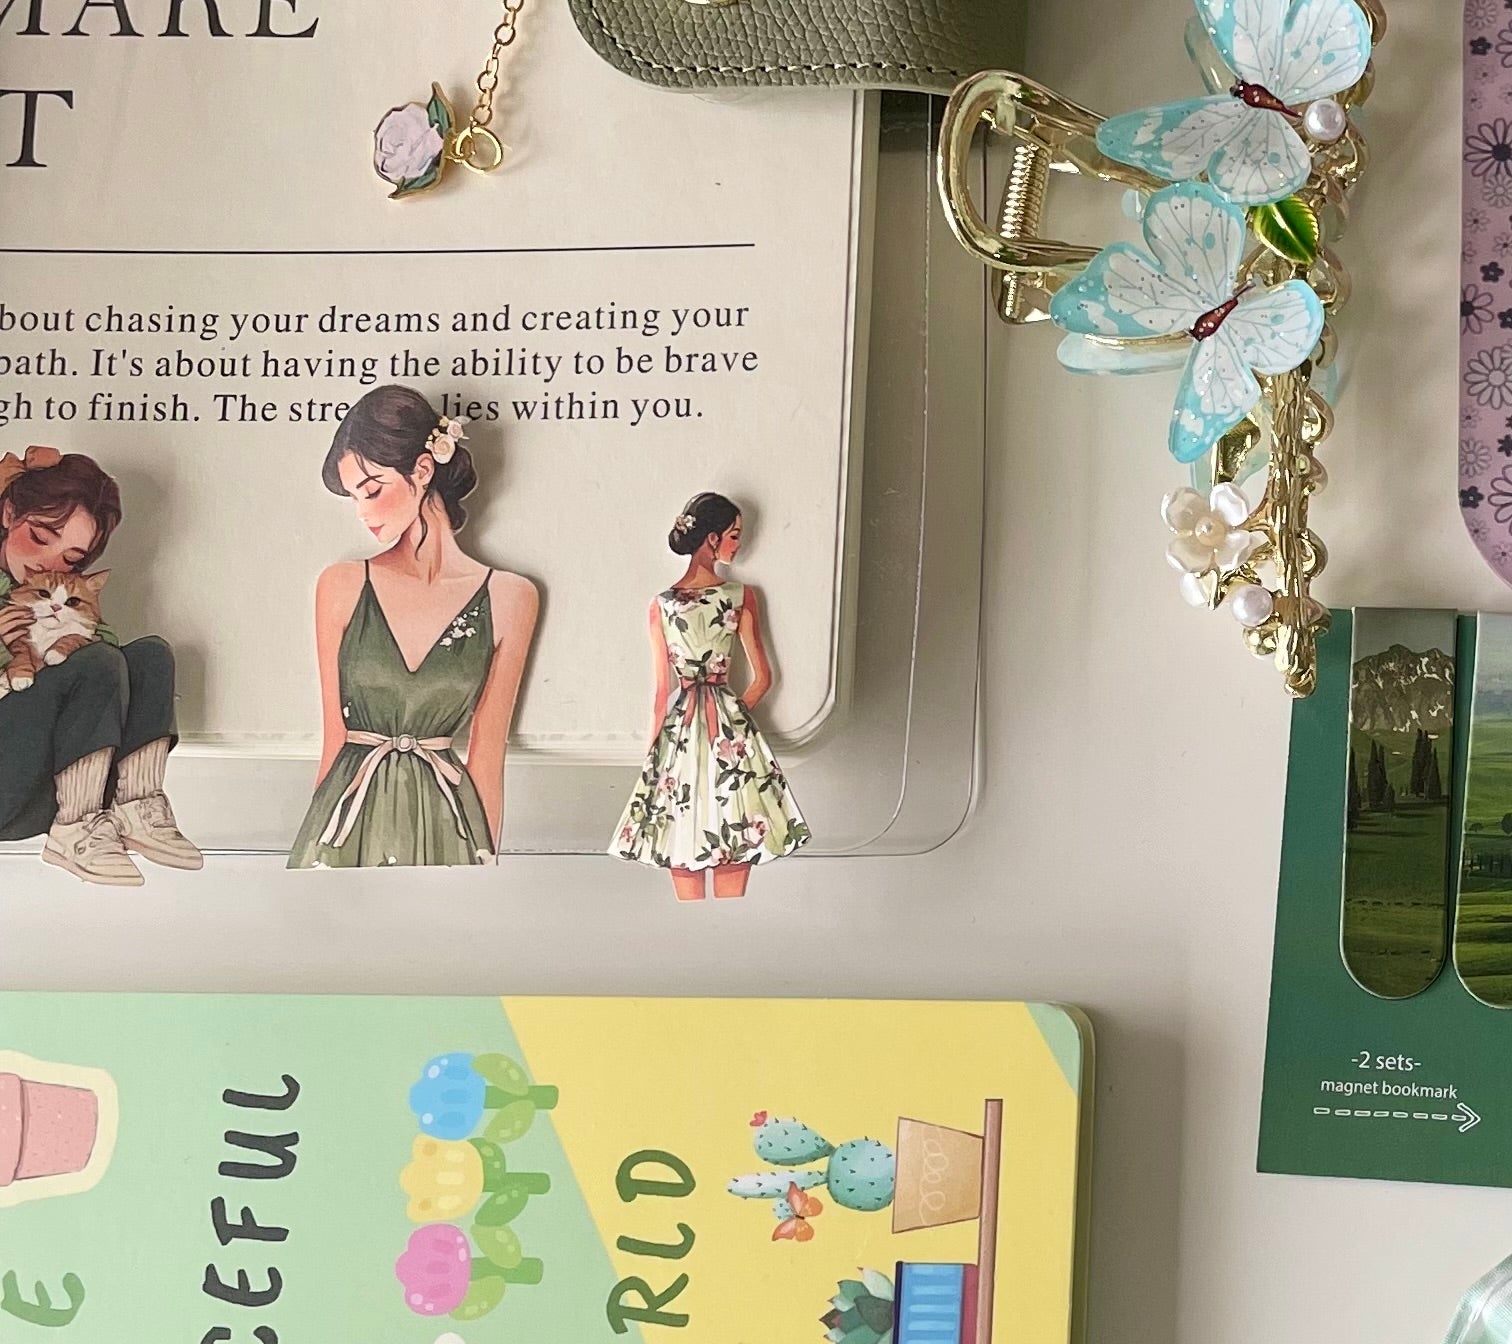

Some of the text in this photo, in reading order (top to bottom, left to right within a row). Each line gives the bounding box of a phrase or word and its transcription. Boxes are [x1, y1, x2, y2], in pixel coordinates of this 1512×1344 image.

[0, 89, 74, 169] T
[0, 301, 750, 341] bout chasing your dreams and creating your
[89, 348, 144, 377] It's
[155, 349, 252, 378] about
[261, 349, 380, 385] having
[390, 349, 441, 378] the
[450, 347, 563, 384] ability
[573, 351, 606, 375] to
[616, 346, 654, 375] be
[664, 345, 760, 375] brave
[44, 396, 77, 421] to
[87, 392, 201, 422] finish.
[213, 393, 278, 422] The
[287, 397, 352, 423] stre
[440, 392, 500, 421] lies
[511, 391, 620, 421] within
[629, 396, 705, 427] you.
[1351, 1050, 1422, 1072] -2 sets-
[1320, 1079, 1458, 1100] magnet bookmark
